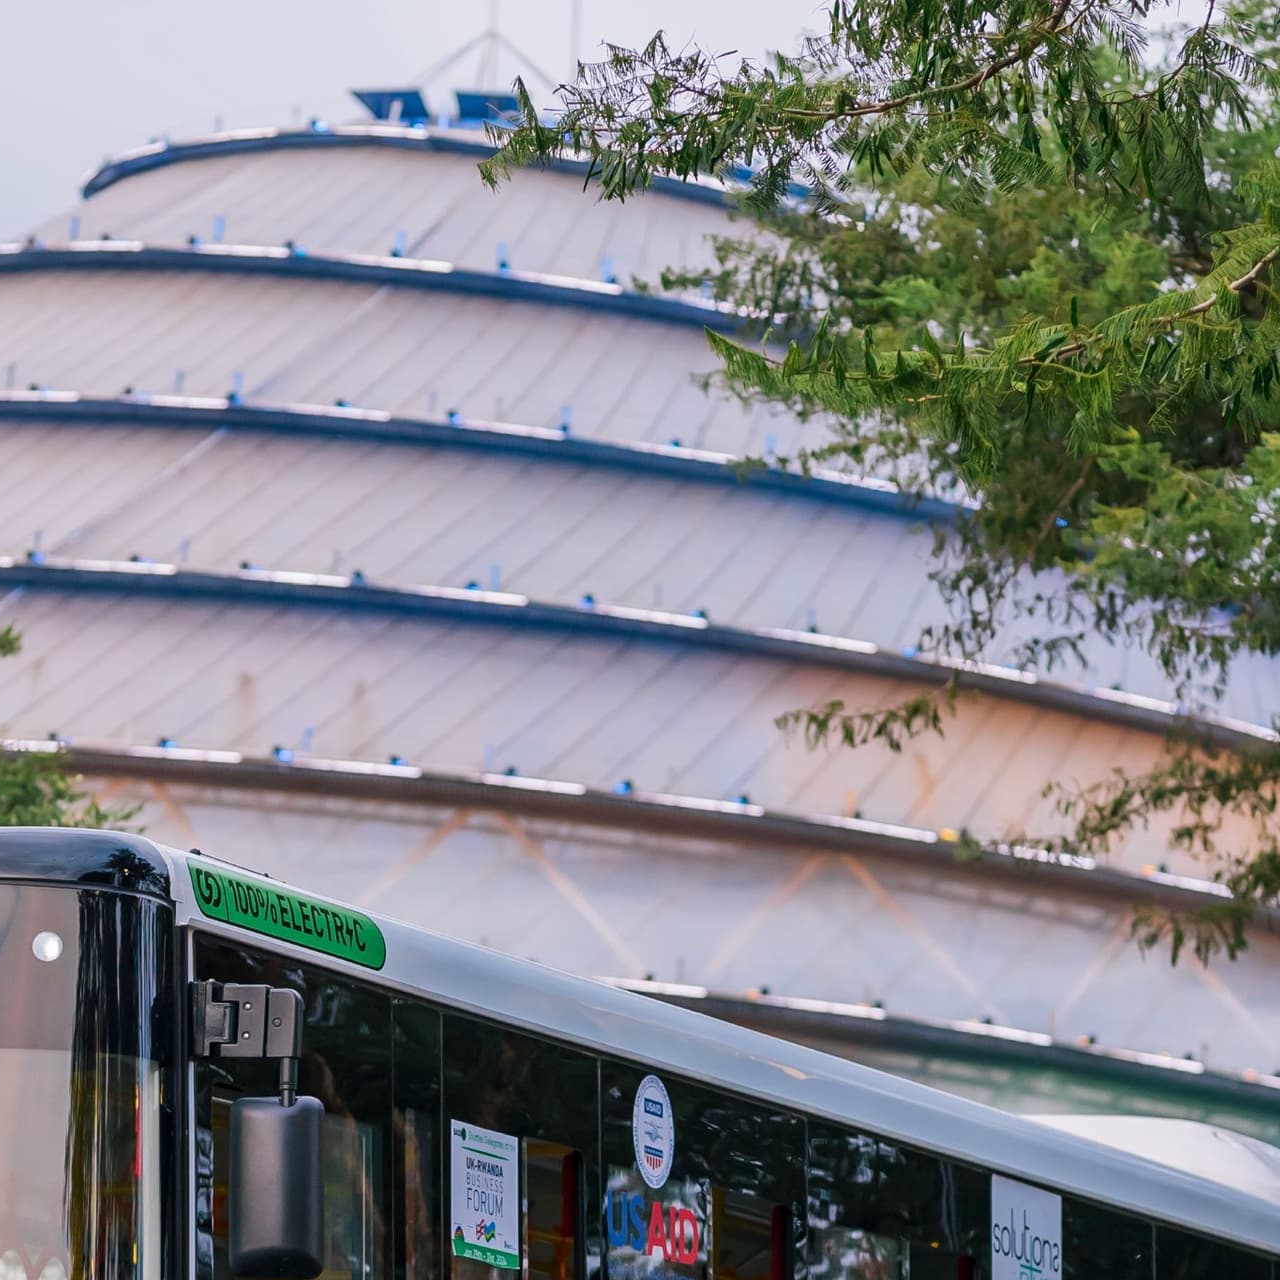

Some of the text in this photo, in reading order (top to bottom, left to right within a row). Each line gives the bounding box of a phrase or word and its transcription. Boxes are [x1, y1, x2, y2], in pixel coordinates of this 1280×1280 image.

[228, 879, 278, 924] 100%
[465, 1156, 504, 1178] UK-RWANDA
[465, 1171, 504, 1194] BUSINESS
[466, 1187, 504, 1218] FORUM
[606, 1188, 700, 1265] USAID
